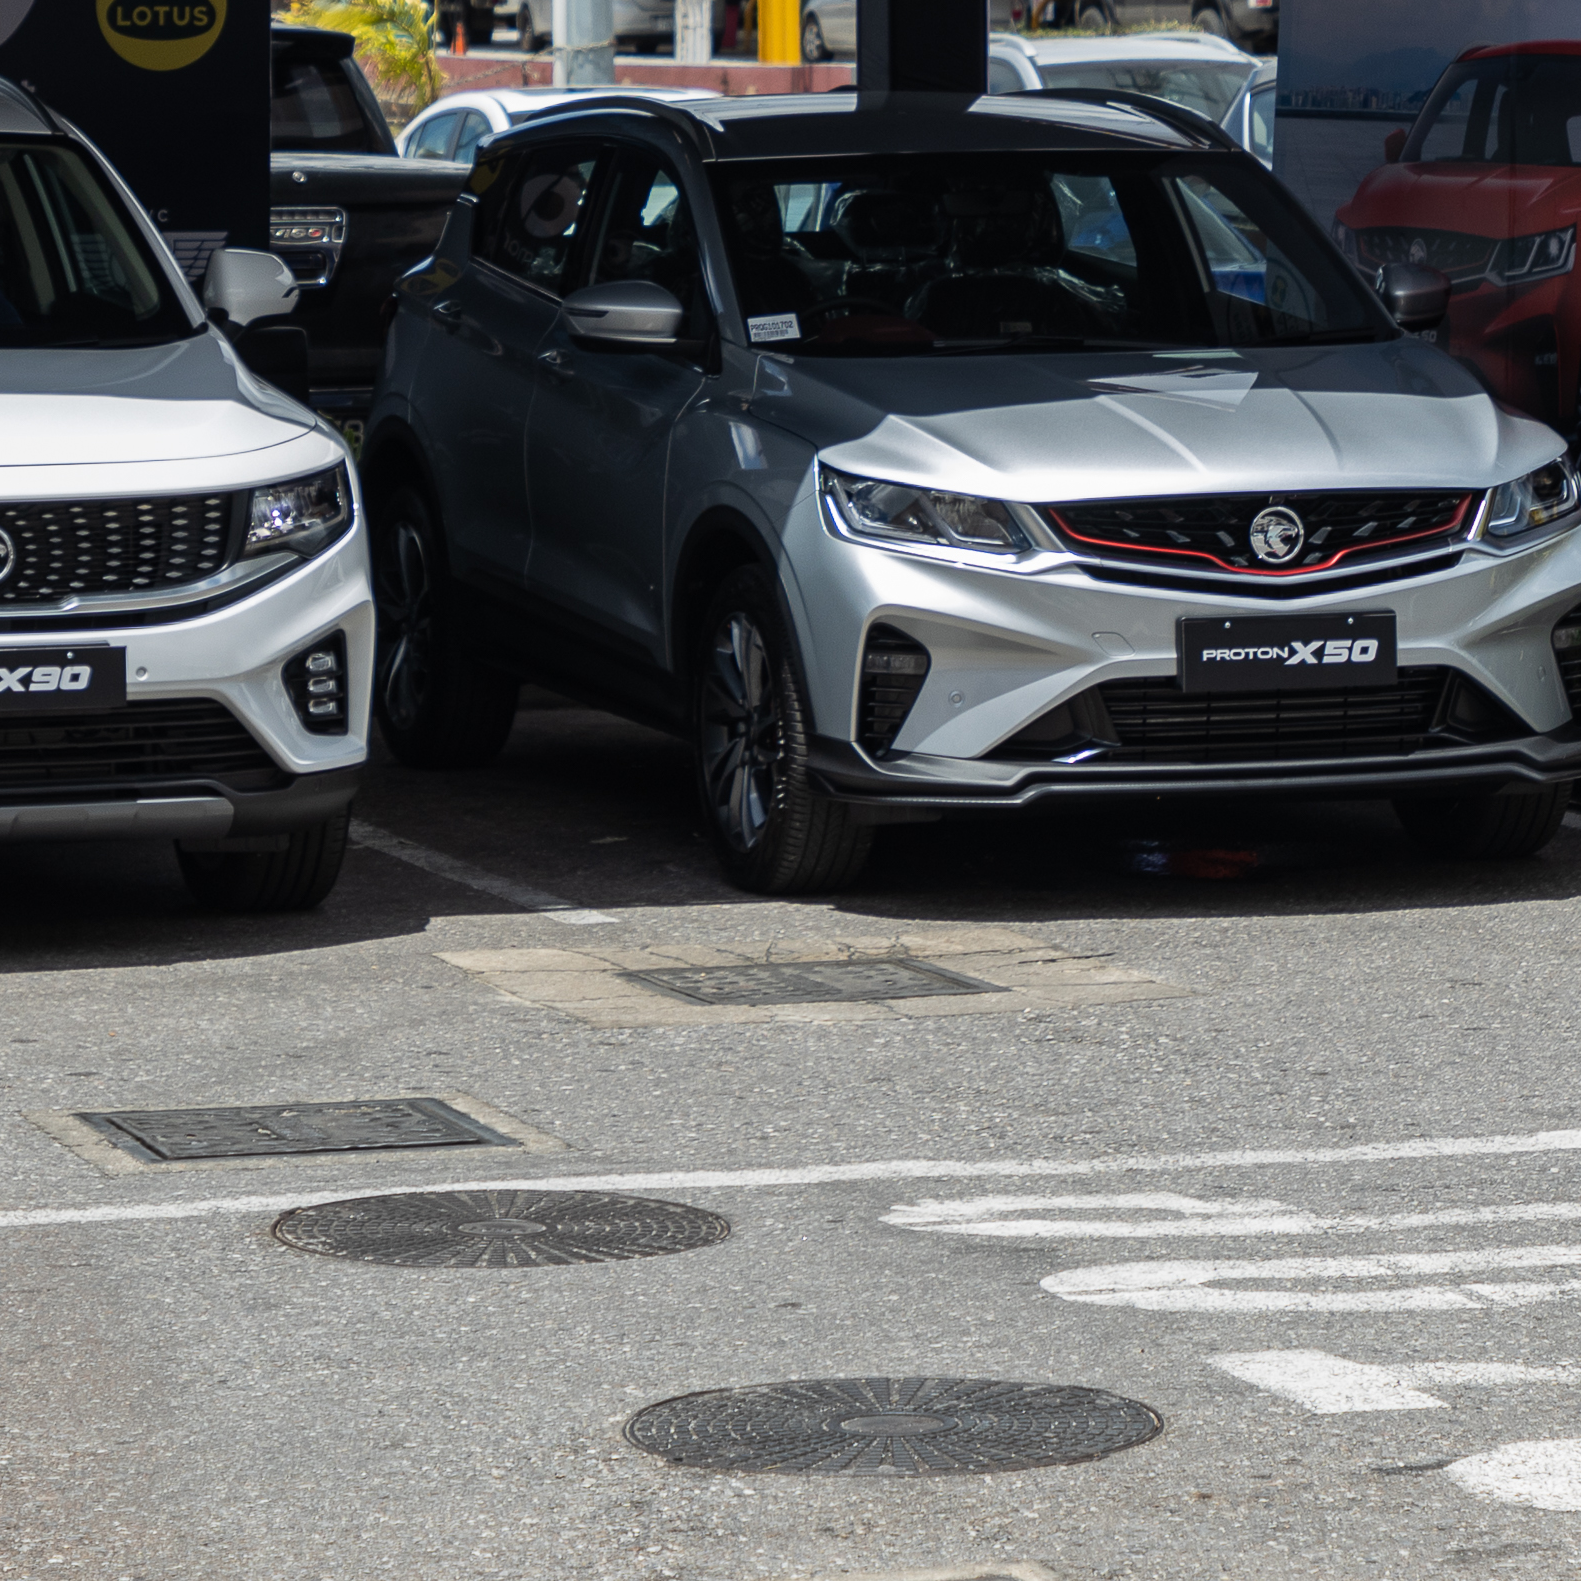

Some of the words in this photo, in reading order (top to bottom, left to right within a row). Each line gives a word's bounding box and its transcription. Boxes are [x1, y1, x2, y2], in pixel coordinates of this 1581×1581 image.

[116, 6, 209, 26] LOTUS
[1202, 646, 1288, 662] PROTON
[1284, 639, 1379, 665] X50
